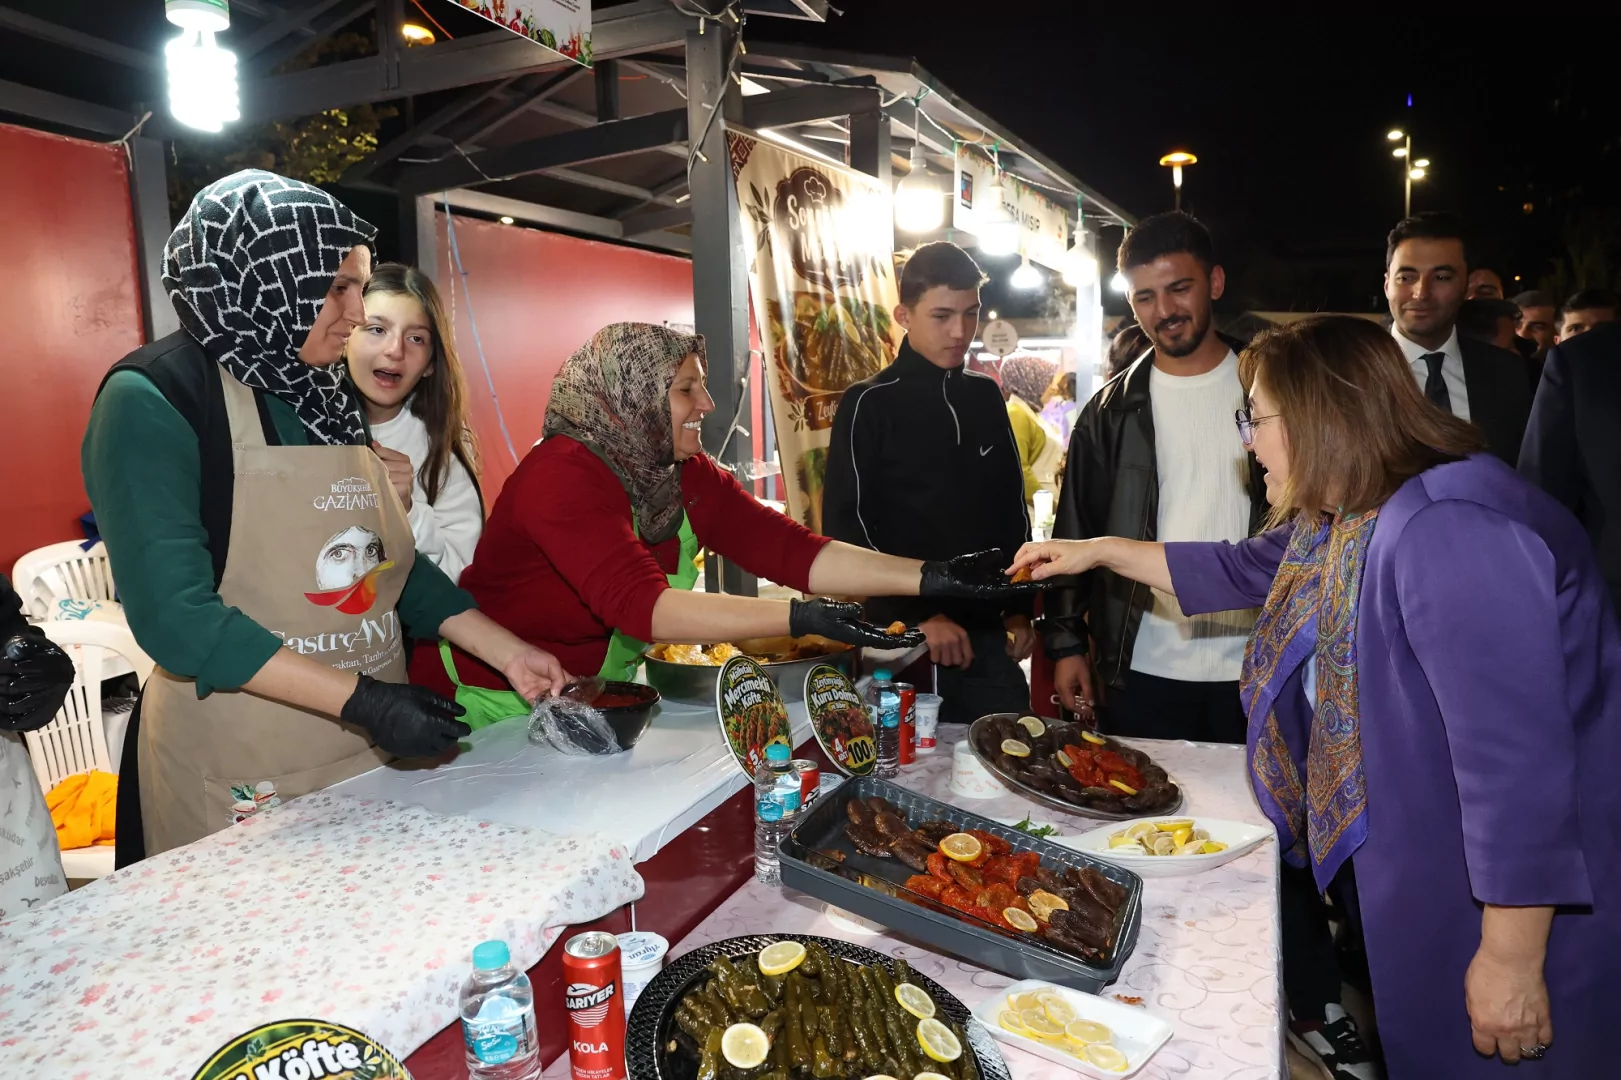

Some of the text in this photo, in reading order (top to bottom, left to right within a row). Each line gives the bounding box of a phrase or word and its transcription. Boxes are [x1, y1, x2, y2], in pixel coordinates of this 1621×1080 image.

[816, 400, 839, 422] Zeyti
[724, 676, 771, 710] Mercimekli
[741, 691, 762, 709] Köfte
[811, 688, 860, 709] Kuru Dolma
[749, 748, 758, 765] 5
[835, 738, 844, 752] 4
[848, 739, 870, 764] 100
[627, 944, 660, 960] Ayran
[566, 983, 614, 1009] SARIYER
[573, 1040, 609, 1054] KOLA
[254, 1040, 362, 1080] Köfte
